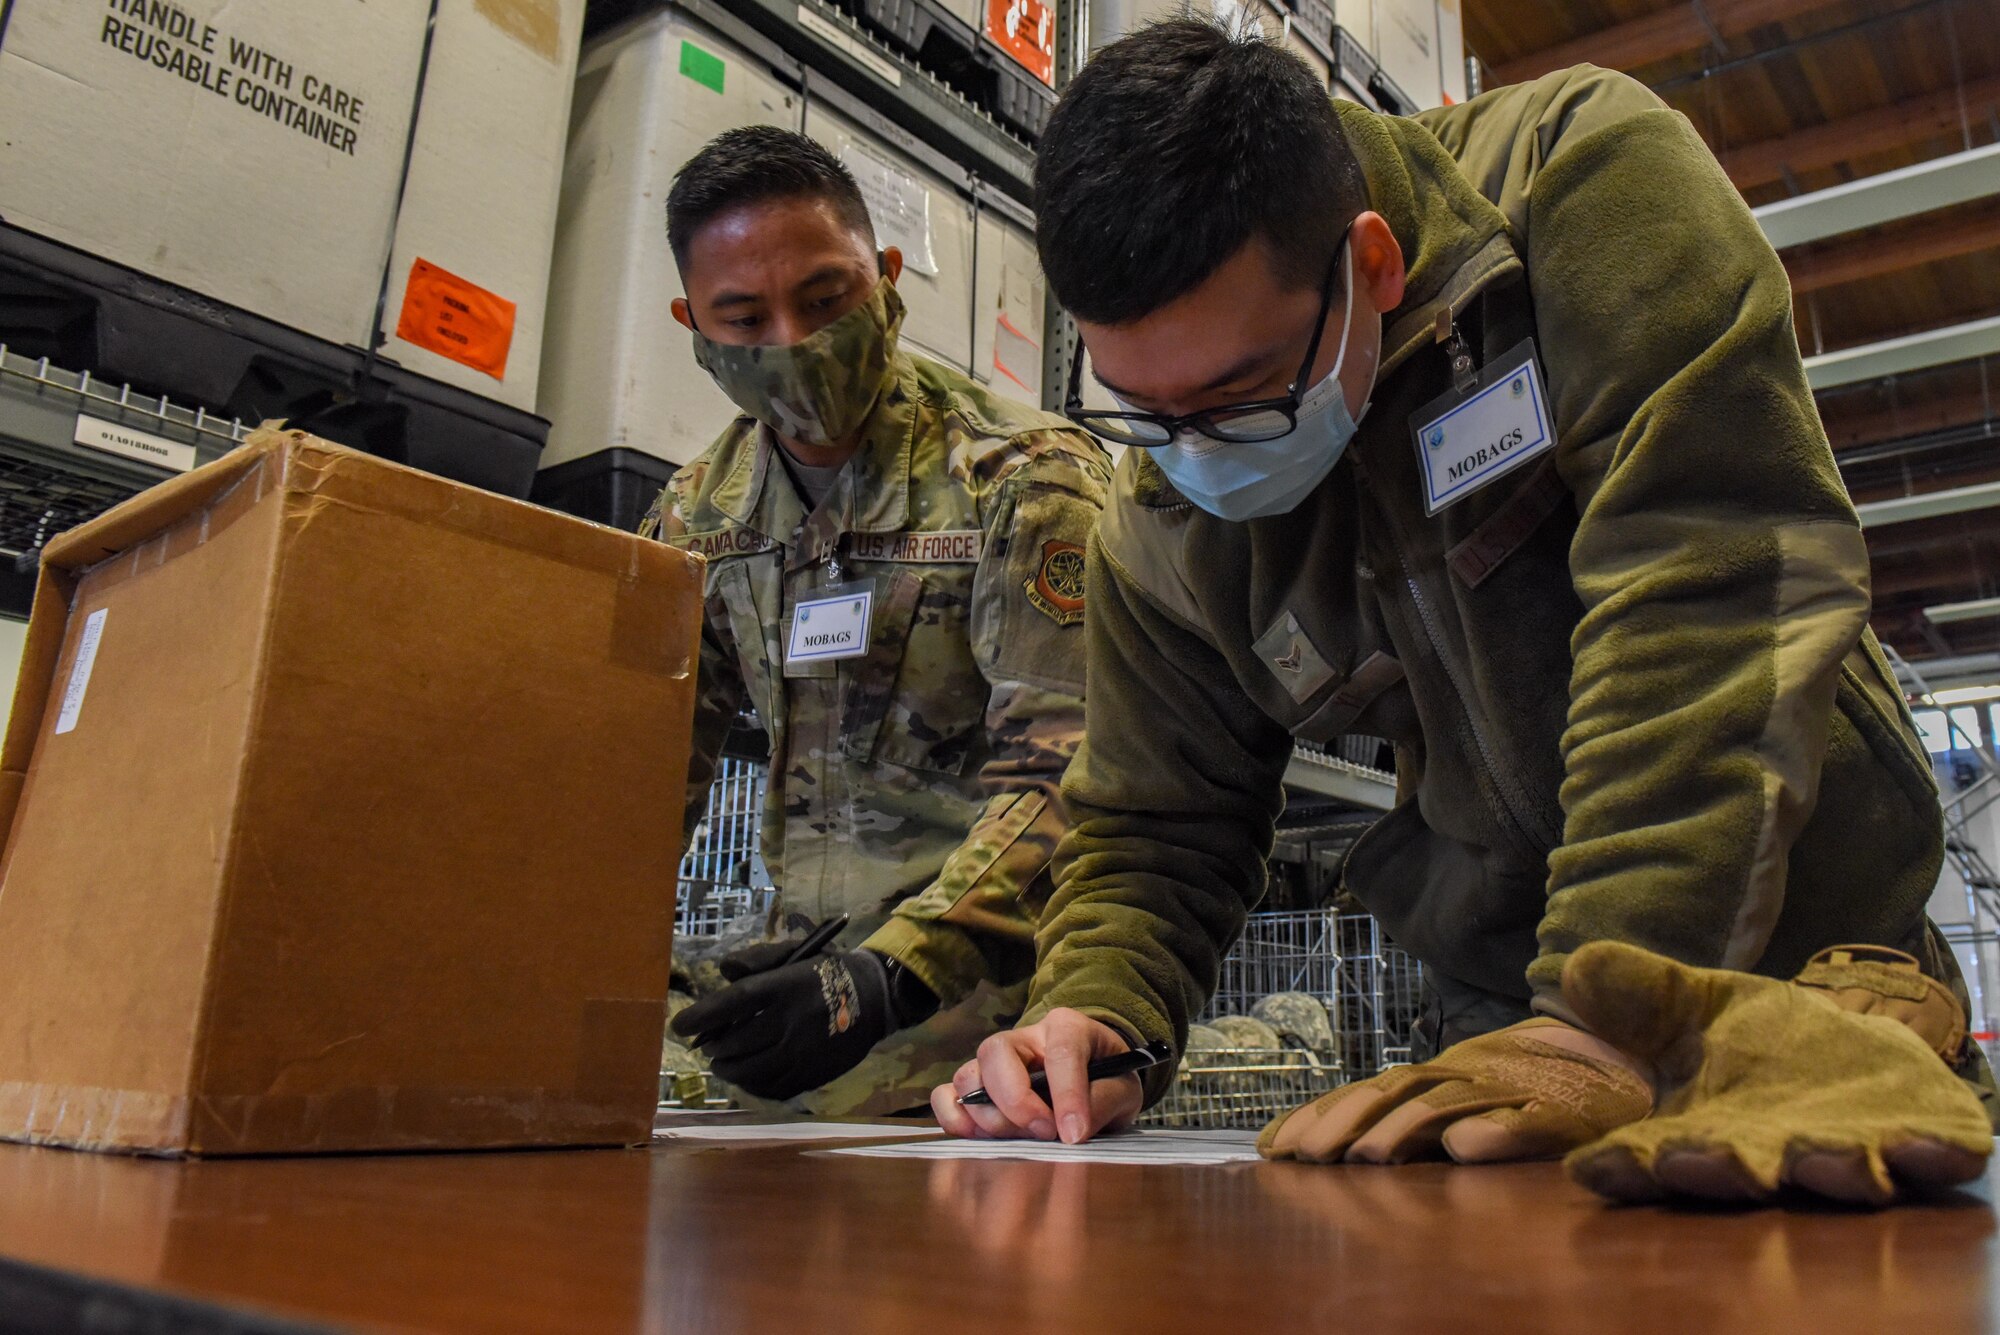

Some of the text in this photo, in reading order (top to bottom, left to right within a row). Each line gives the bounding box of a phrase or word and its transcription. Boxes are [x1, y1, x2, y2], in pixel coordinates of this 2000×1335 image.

[101, 15, 358, 156] REUSABLE CONTAINER
[229, 37, 293, 90] WITH
[302, 75, 364, 124] CARE
[1447, 427, 1524, 482] MOBAGS
[857, 536, 974, 559] U.S. AIR FORCE
[802, 630, 852, 648] MOBAGS
